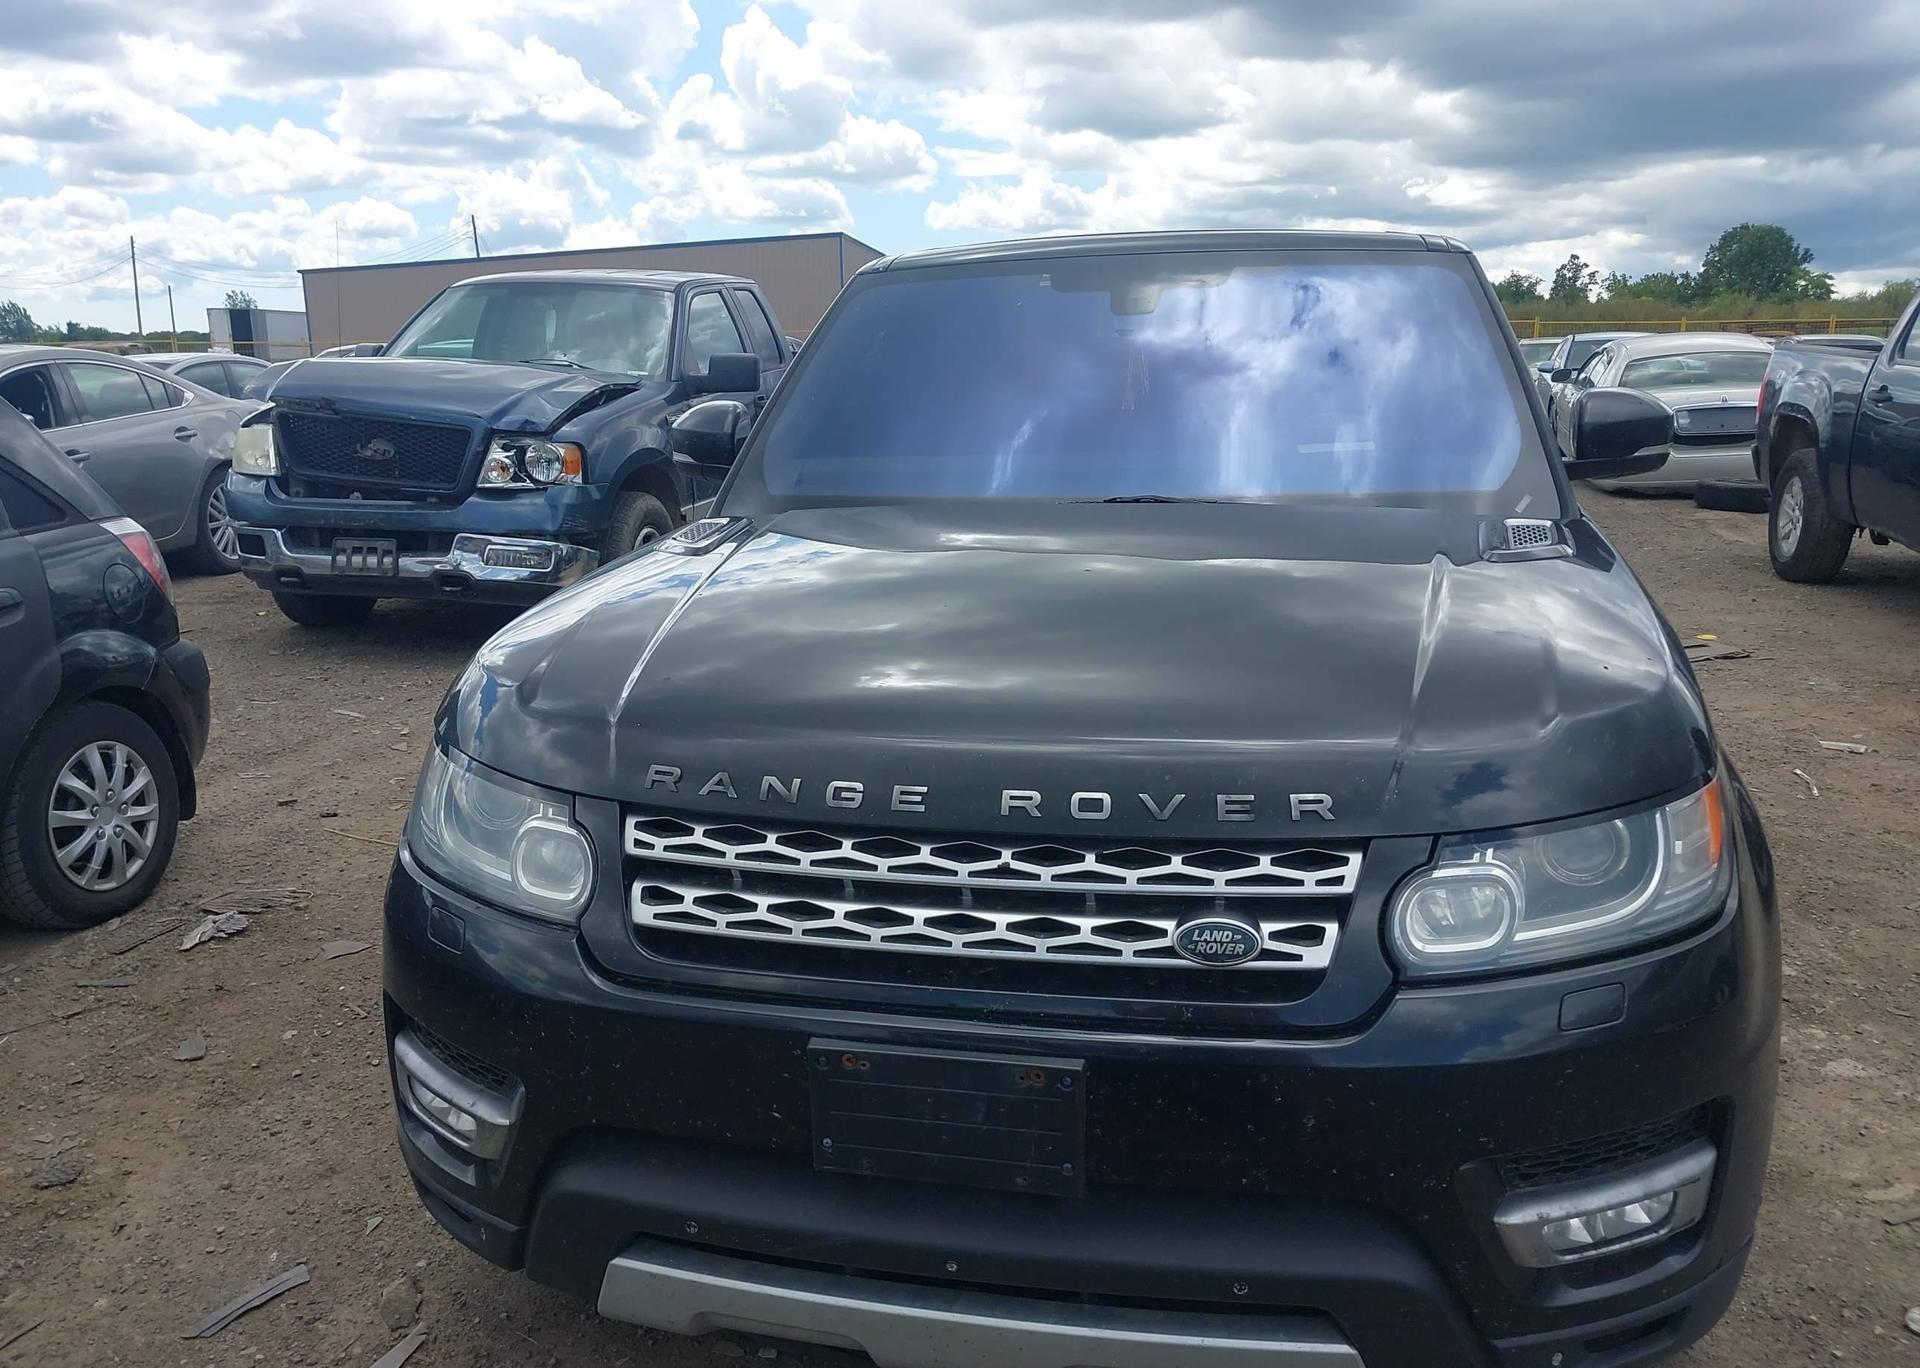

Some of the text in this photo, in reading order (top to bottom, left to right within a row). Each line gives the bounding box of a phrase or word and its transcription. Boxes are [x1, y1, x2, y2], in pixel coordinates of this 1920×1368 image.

[644, 764, 1336, 821] RANGE ROVER
[1192, 929, 1233, 942] LAND
